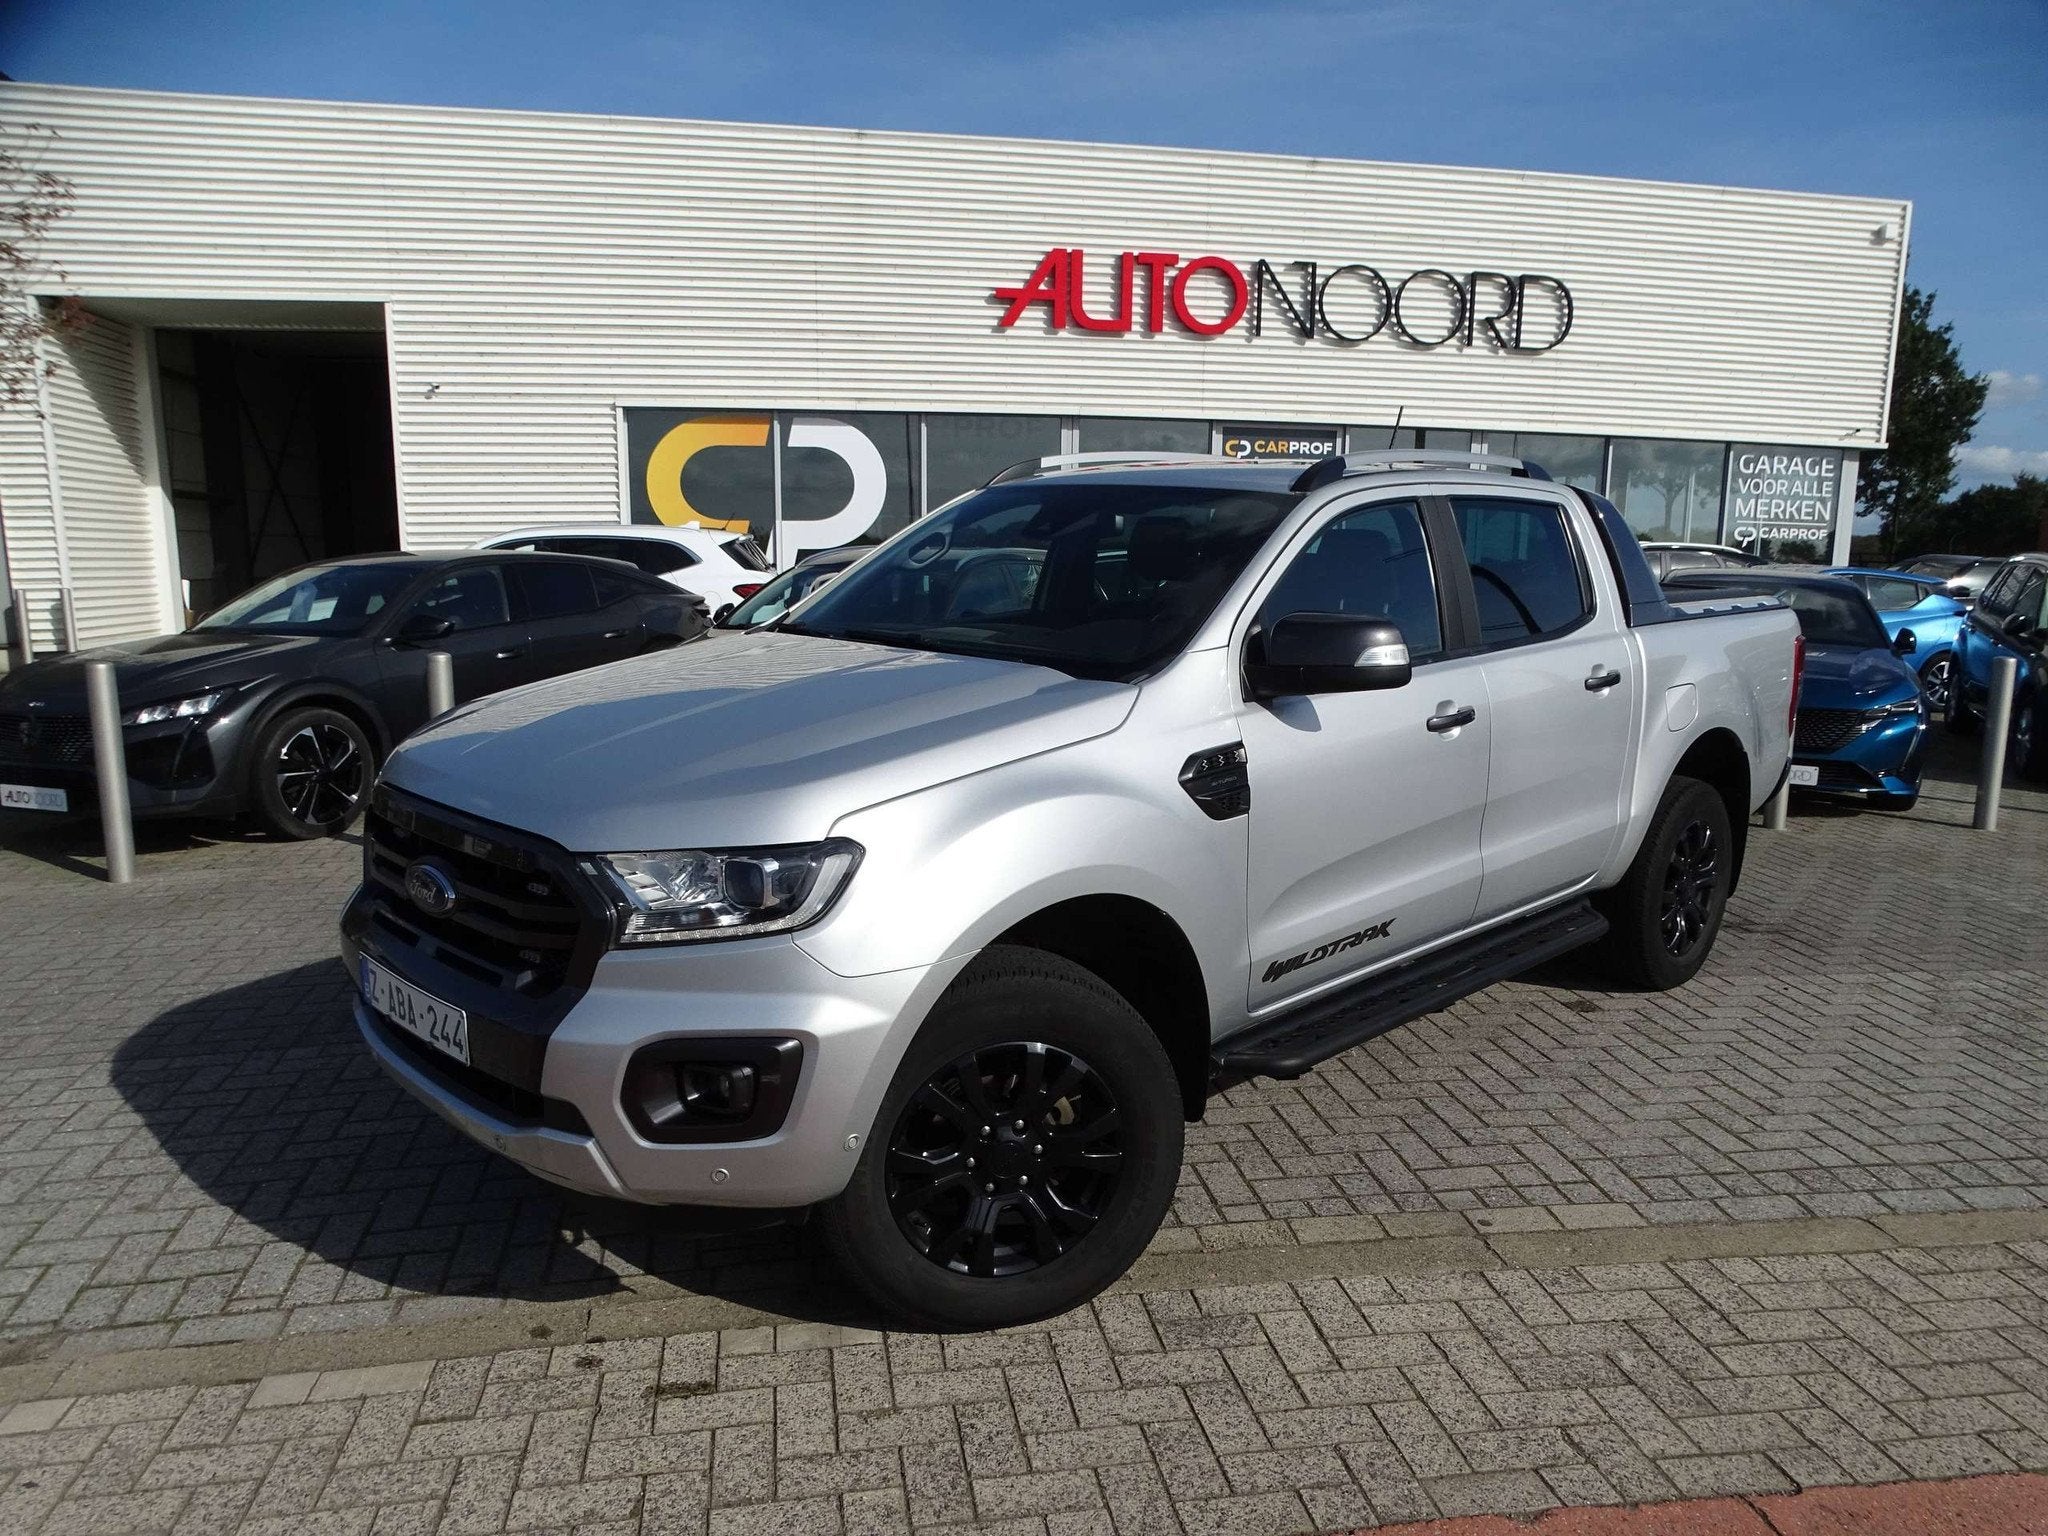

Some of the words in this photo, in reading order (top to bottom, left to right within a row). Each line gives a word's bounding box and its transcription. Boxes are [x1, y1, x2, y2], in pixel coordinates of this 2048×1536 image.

[1254, 440, 1333, 455] CARPROF
[1739, 454, 1834, 477] GARAGE
[1738, 478, 1787, 496] VOOR
[1790, 480, 1833, 497] ALLE
[1734, 498, 1832, 521] MERKEN
[1759, 527, 1829, 540] CARPROF
[1261, 917, 1397, 983] WILDTRAK
